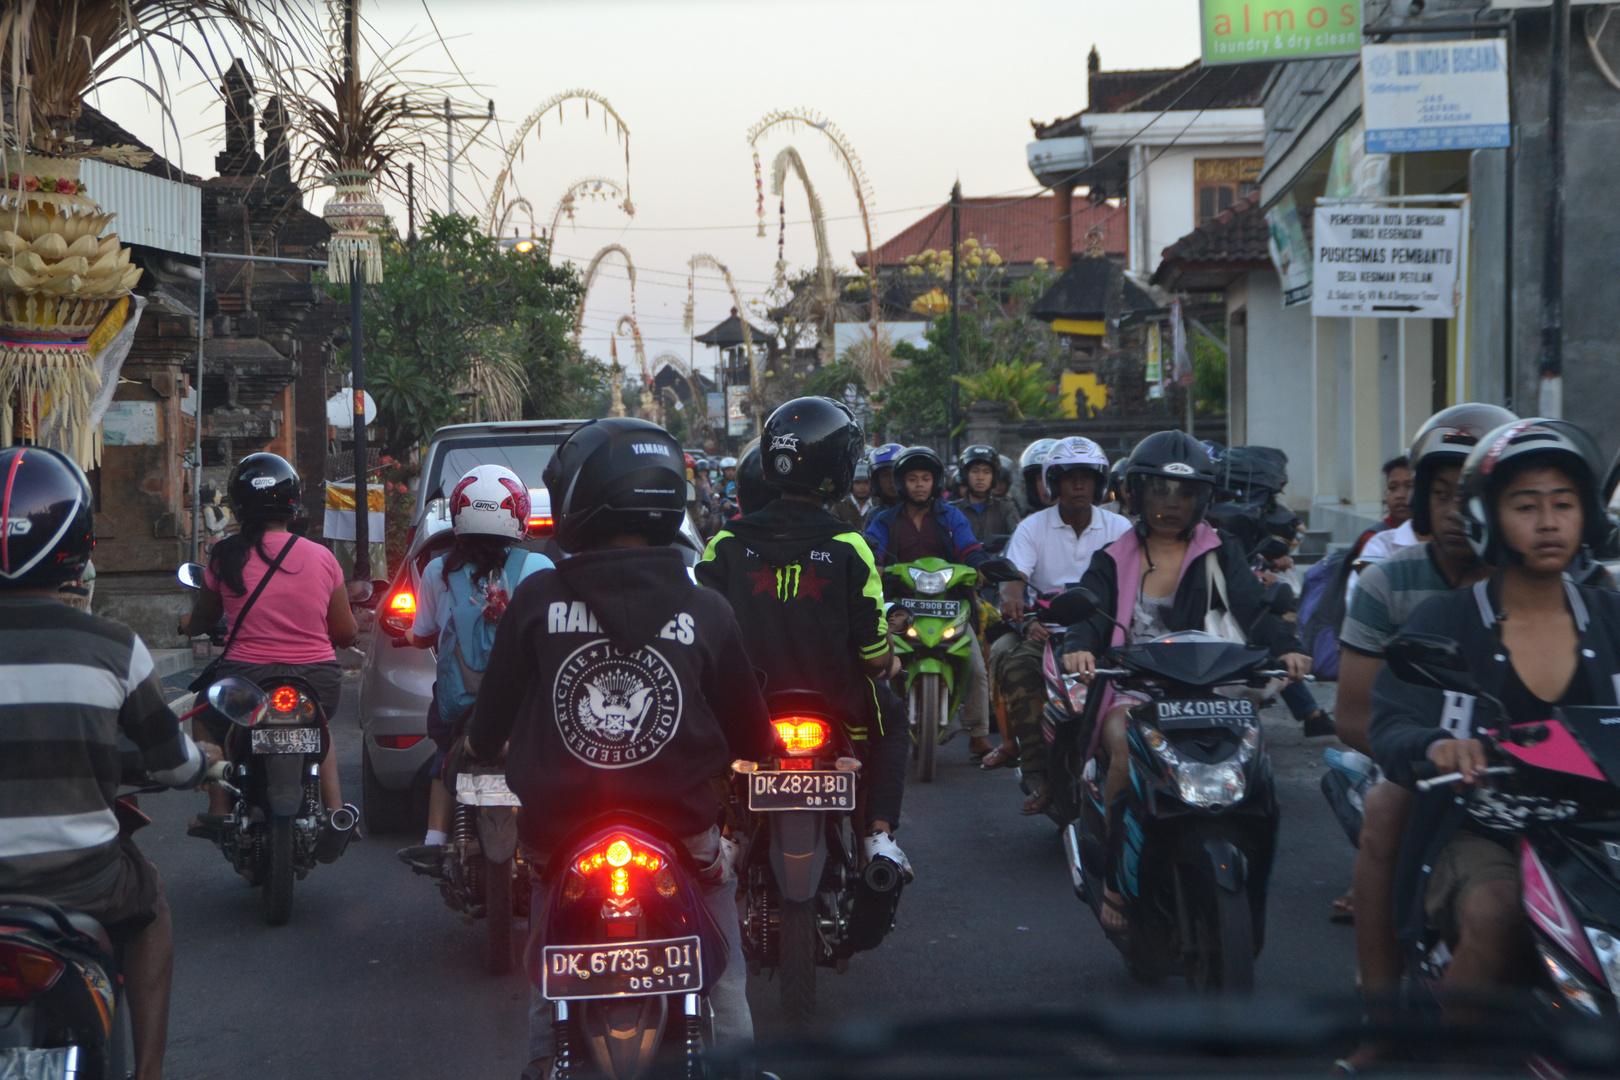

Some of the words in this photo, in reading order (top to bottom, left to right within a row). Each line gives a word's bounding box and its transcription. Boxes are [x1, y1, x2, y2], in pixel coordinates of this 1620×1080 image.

[1214, 4, 1356, 36] almos
[1214, 38, 1269, 54] laundry
[1274, 35, 1283, 49] &
[1288, 34, 1311, 51] dry
[1316, 32, 1355, 46] clean
[1330, 214, 1381, 226] PEMERINTAH
[1384, 214, 1402, 226] KOTA
[1406, 215, 1446, 227] DENPASAR
[1352, 228, 1375, 240] DINAS
[1378, 228, 1423, 240] KESEHATAN
[1320, 247, 1386, 264] PUSKESMAS
[1391, 248, 1453, 265] PEMBANTU
[1337, 271, 1356, 283] DESA
[1360, 271, 1396, 283] KESIMAN
[1400, 272, 1433, 283] PETILAN
[631, 443, 670, 457] YAMAHA
[904, 600, 916, 609] DK
[920, 602, 943, 610] 3908
[944, 602, 956, 611] CK
[558, 655, 588, 723] RICHIE
[649, 704, 675, 749] JOEY
[754, 776, 778, 795] DK
[780, 775, 821, 794] 4821
[824, 775, 848, 793] BD
[553, 953, 584, 975] DK
[591, 948, 650, 973] 6735
[665, 945, 691, 968] DI
